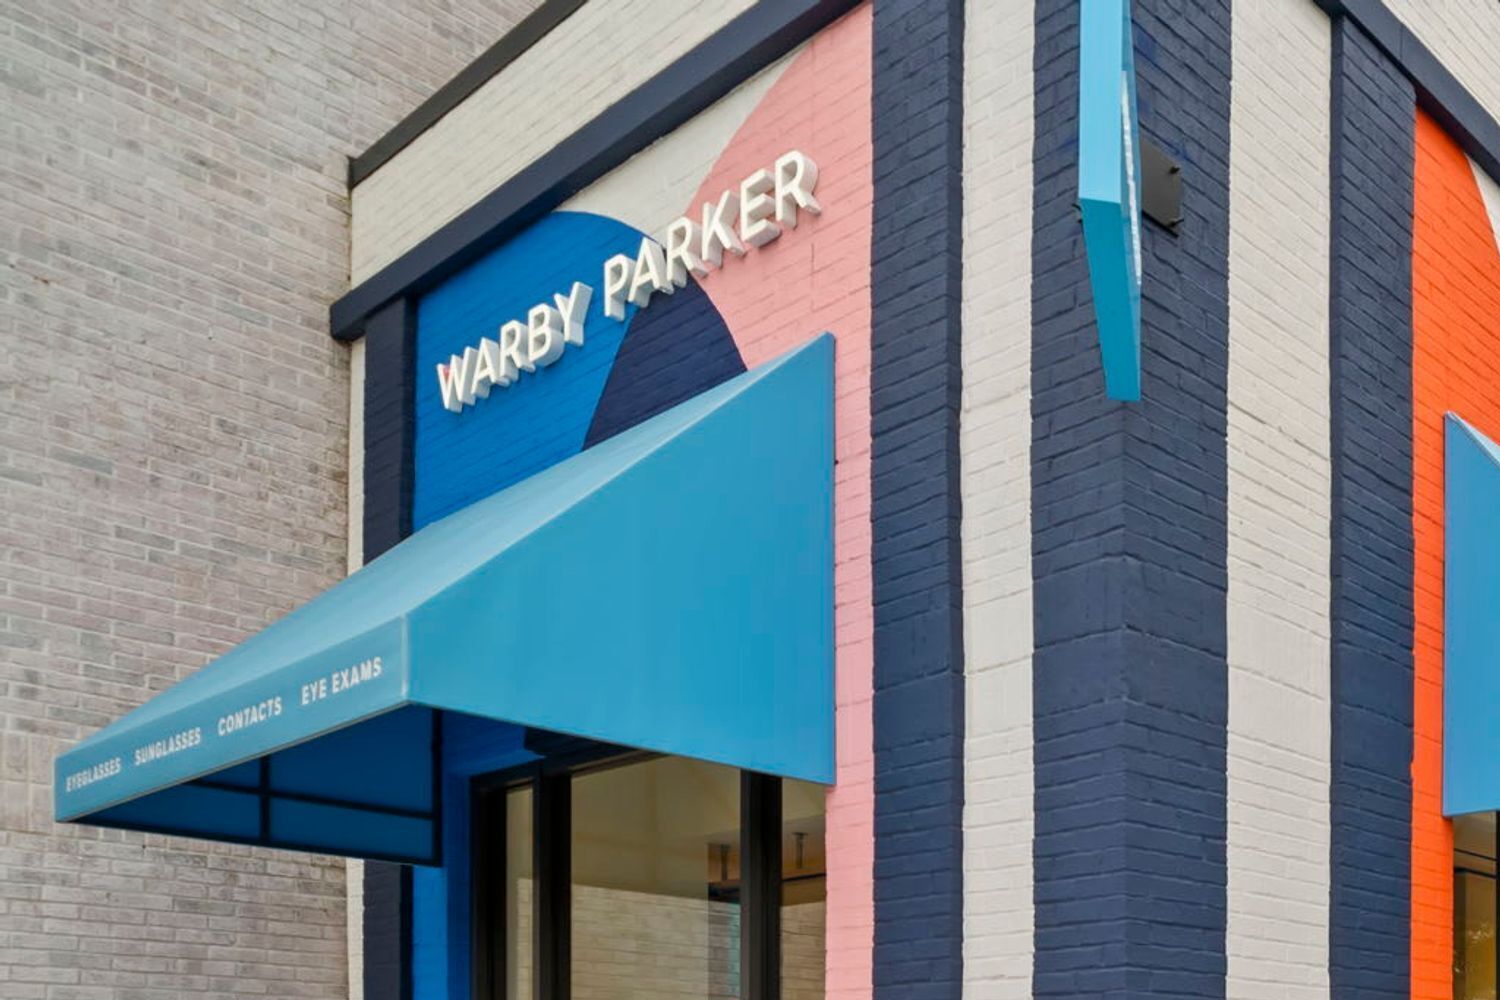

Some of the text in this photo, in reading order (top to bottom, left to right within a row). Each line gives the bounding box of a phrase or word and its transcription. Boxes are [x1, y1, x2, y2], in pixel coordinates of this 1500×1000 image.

[437, 150, 821, 413] WARBY PARKER
[66, 656, 383, 793] EYEGLASSES SUNGLASSES CONTACTS EYE EXAMS
